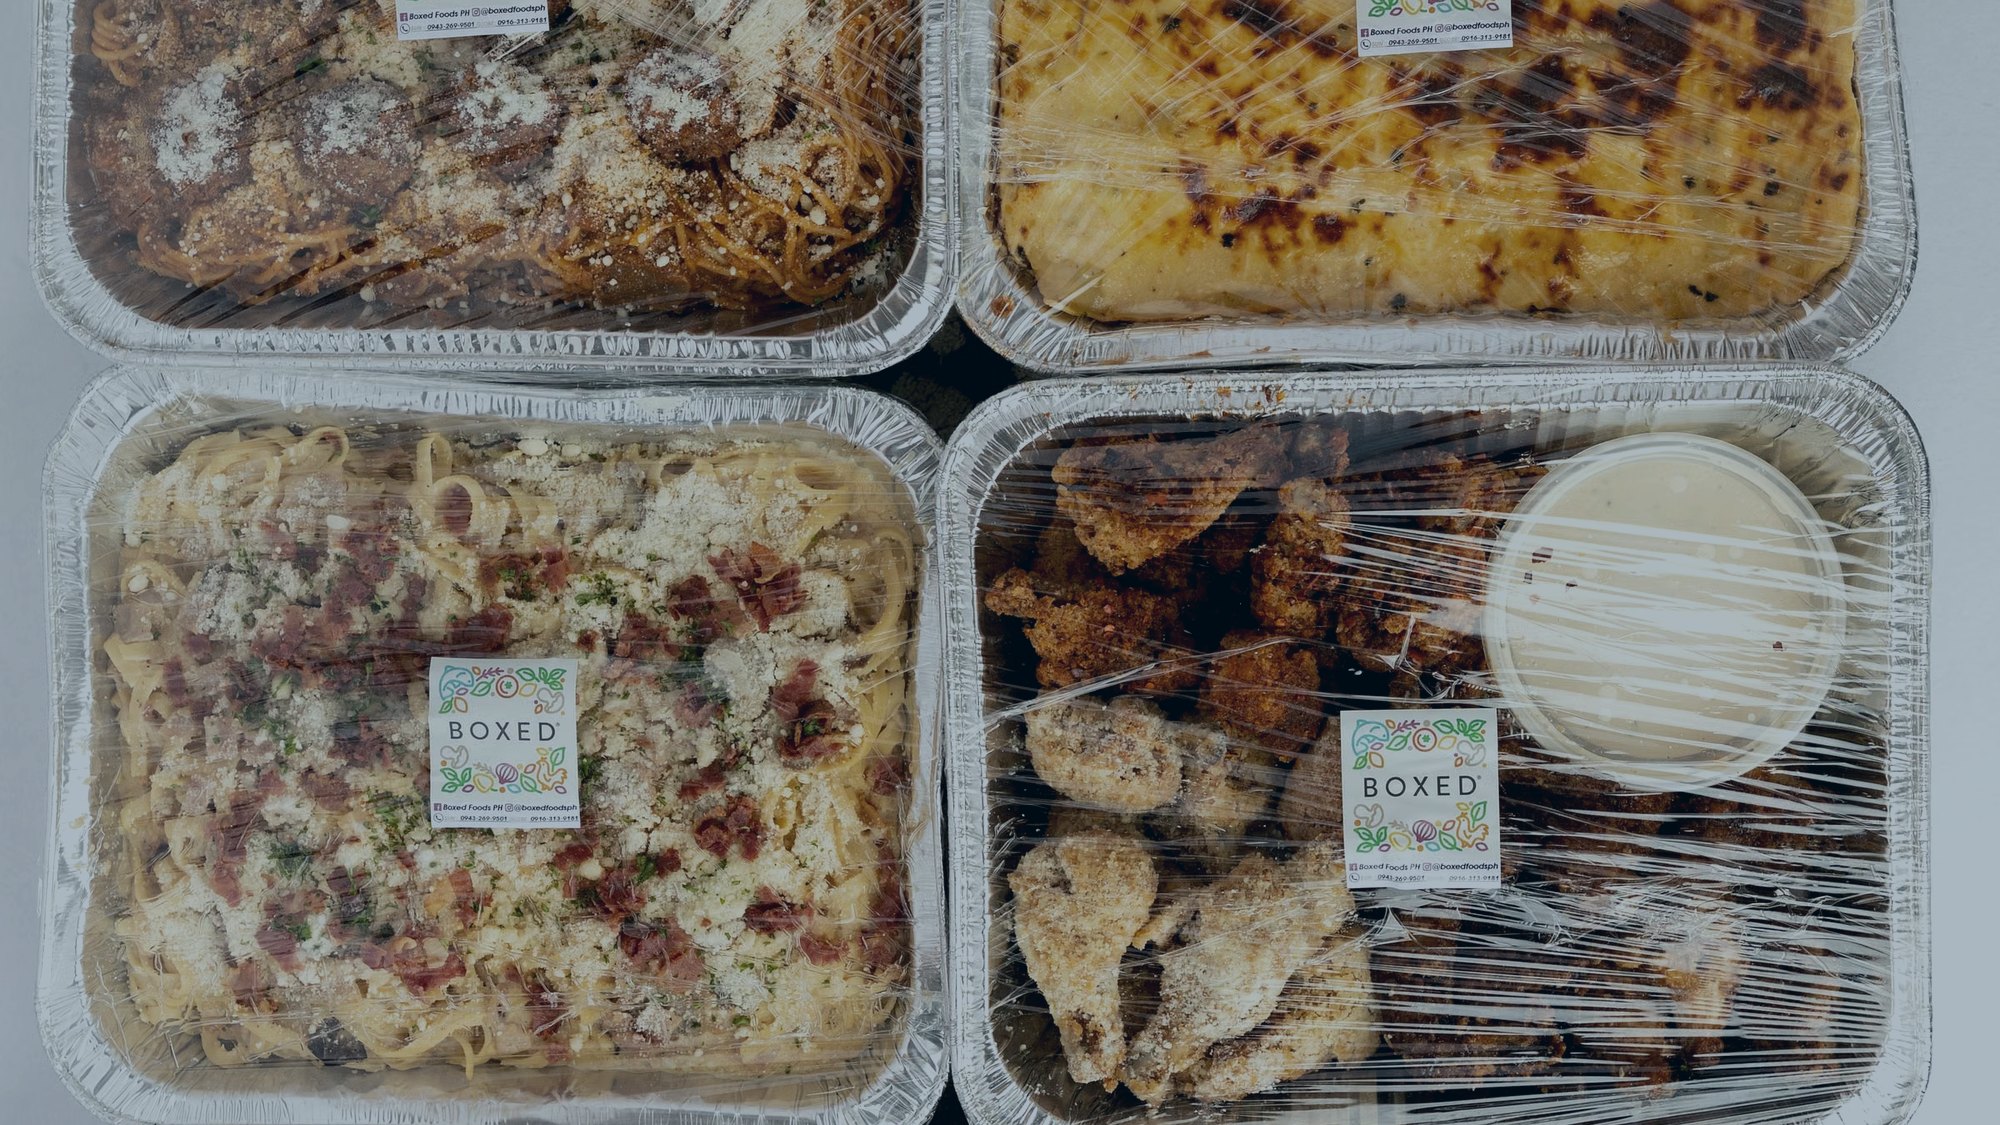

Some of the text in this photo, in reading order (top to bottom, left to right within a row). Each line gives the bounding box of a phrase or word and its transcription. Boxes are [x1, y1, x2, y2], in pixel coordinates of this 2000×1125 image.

[409, 5, 546, 20] Boxed Foods PH @boxedfoodsph
[427, 22, 475, 30] 0943-269-9501
[1370, 28, 1395, 36] Boxed
[1445, 21, 1510, 32] @boxedfoodsph
[1388, 38, 1438, 46] 0943-269-9501
[1461, 33, 1511, 41] 0916-313-9181
[449, 721, 556, 741] BOXED
[1363, 775, 1477, 798] BOXED
[514, 804, 577, 812] @boxedfoodsph
[1432, 862, 1499, 871] @boxedfoodsph
